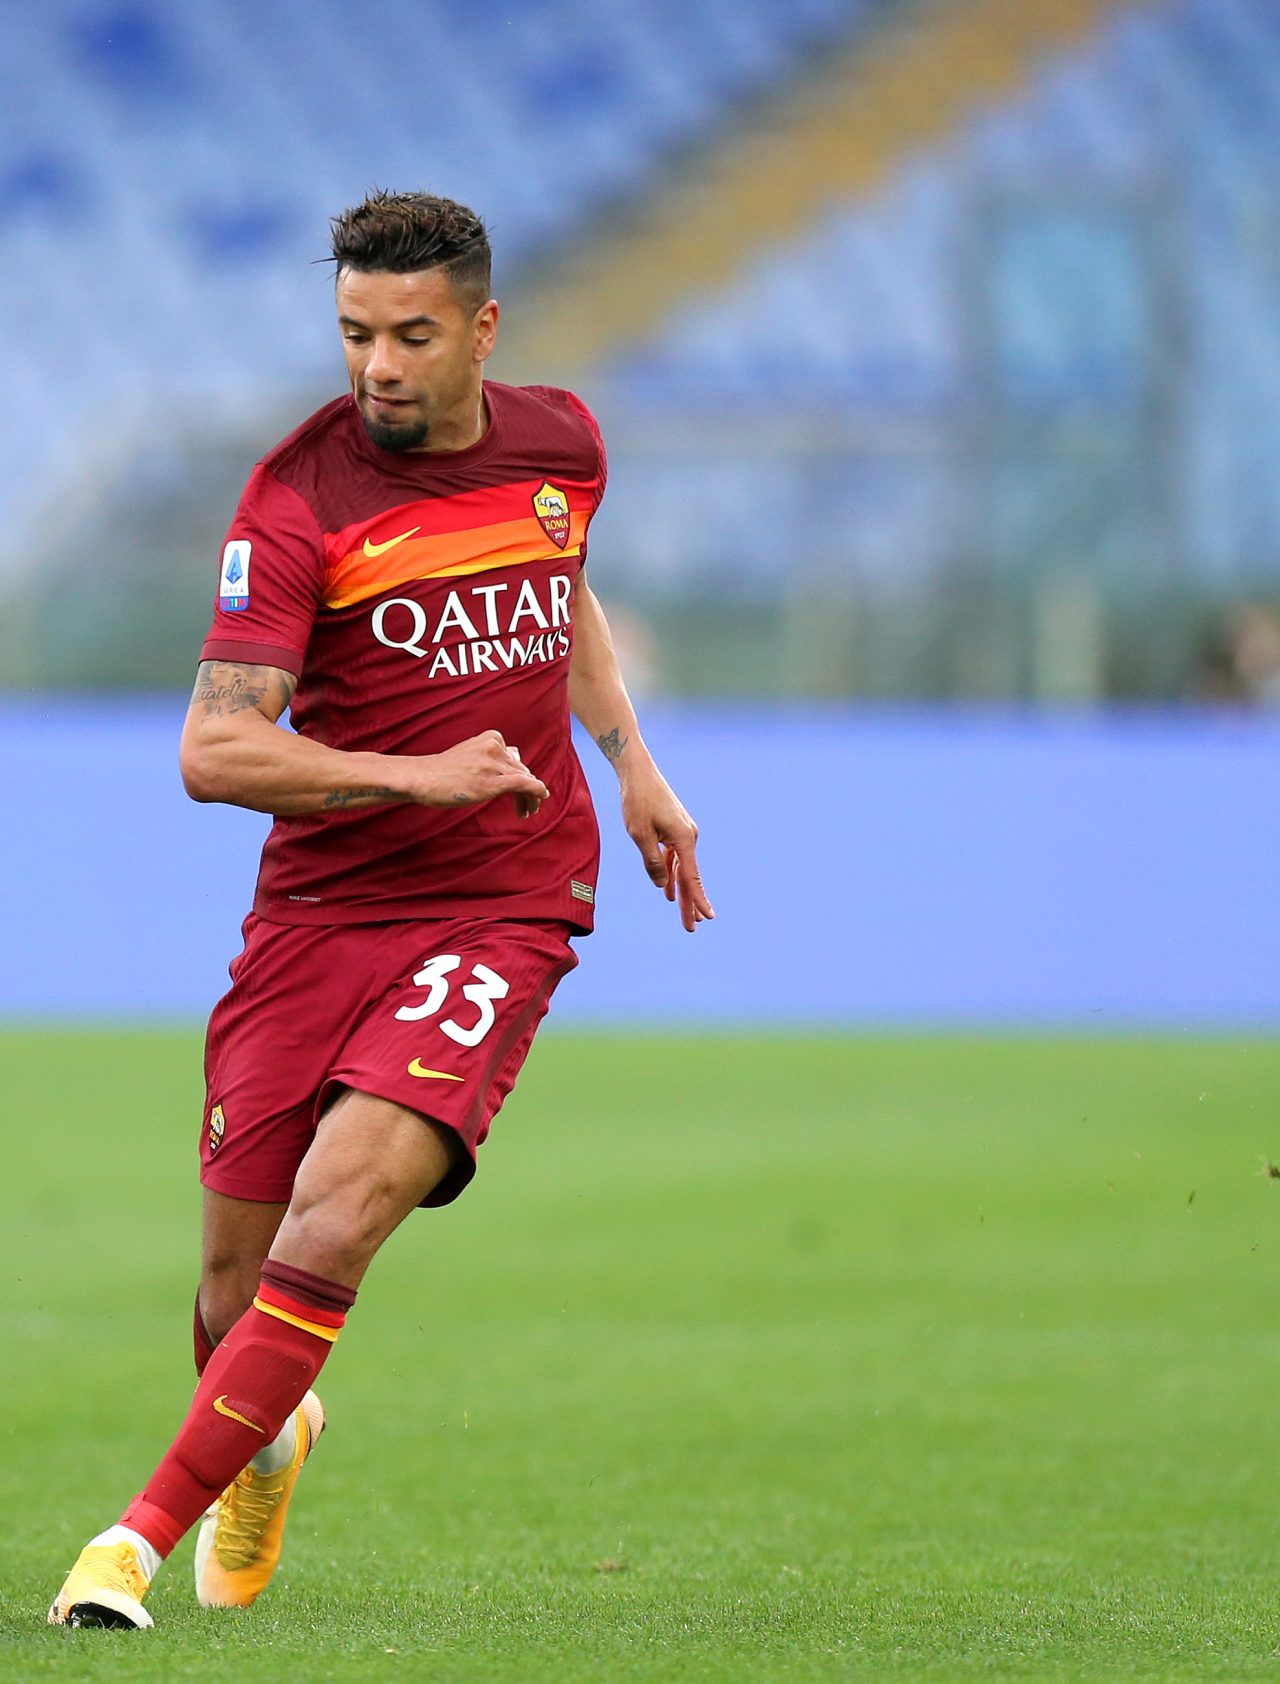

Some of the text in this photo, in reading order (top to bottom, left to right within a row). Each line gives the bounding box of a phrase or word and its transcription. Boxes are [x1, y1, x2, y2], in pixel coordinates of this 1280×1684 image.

[544, 519, 569, 531] ROMA
[371, 575, 571, 658] QATAR
[428, 627, 570, 679] AIRWAYS
[394, 954, 510, 1047] 33
